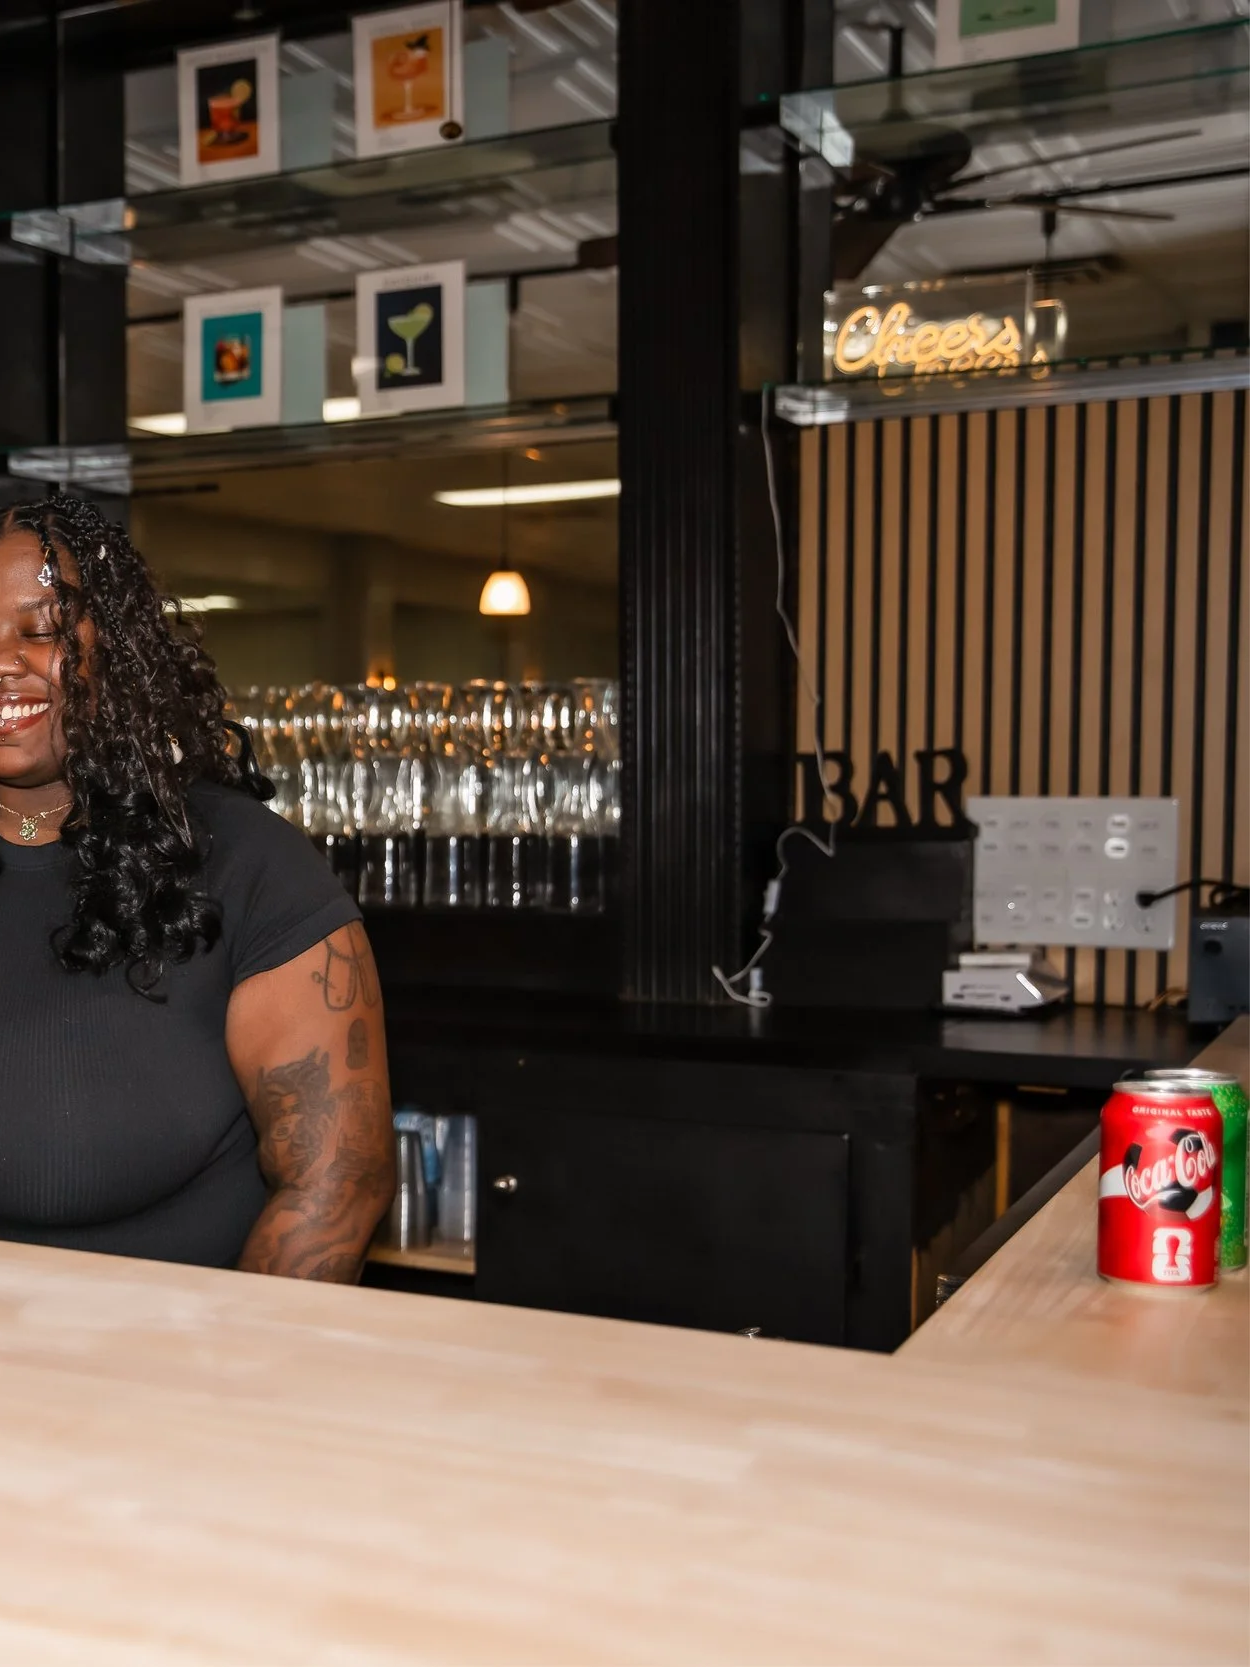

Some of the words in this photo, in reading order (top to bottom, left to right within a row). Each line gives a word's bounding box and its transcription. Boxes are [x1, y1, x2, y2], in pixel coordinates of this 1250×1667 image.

[835, 302, 1021, 372] Cheers
[793, 750, 974, 828] BAR
[1132, 1106, 1183, 1116] ORIGINAL
[1186, 1108, 1212, 1117] TASTE
